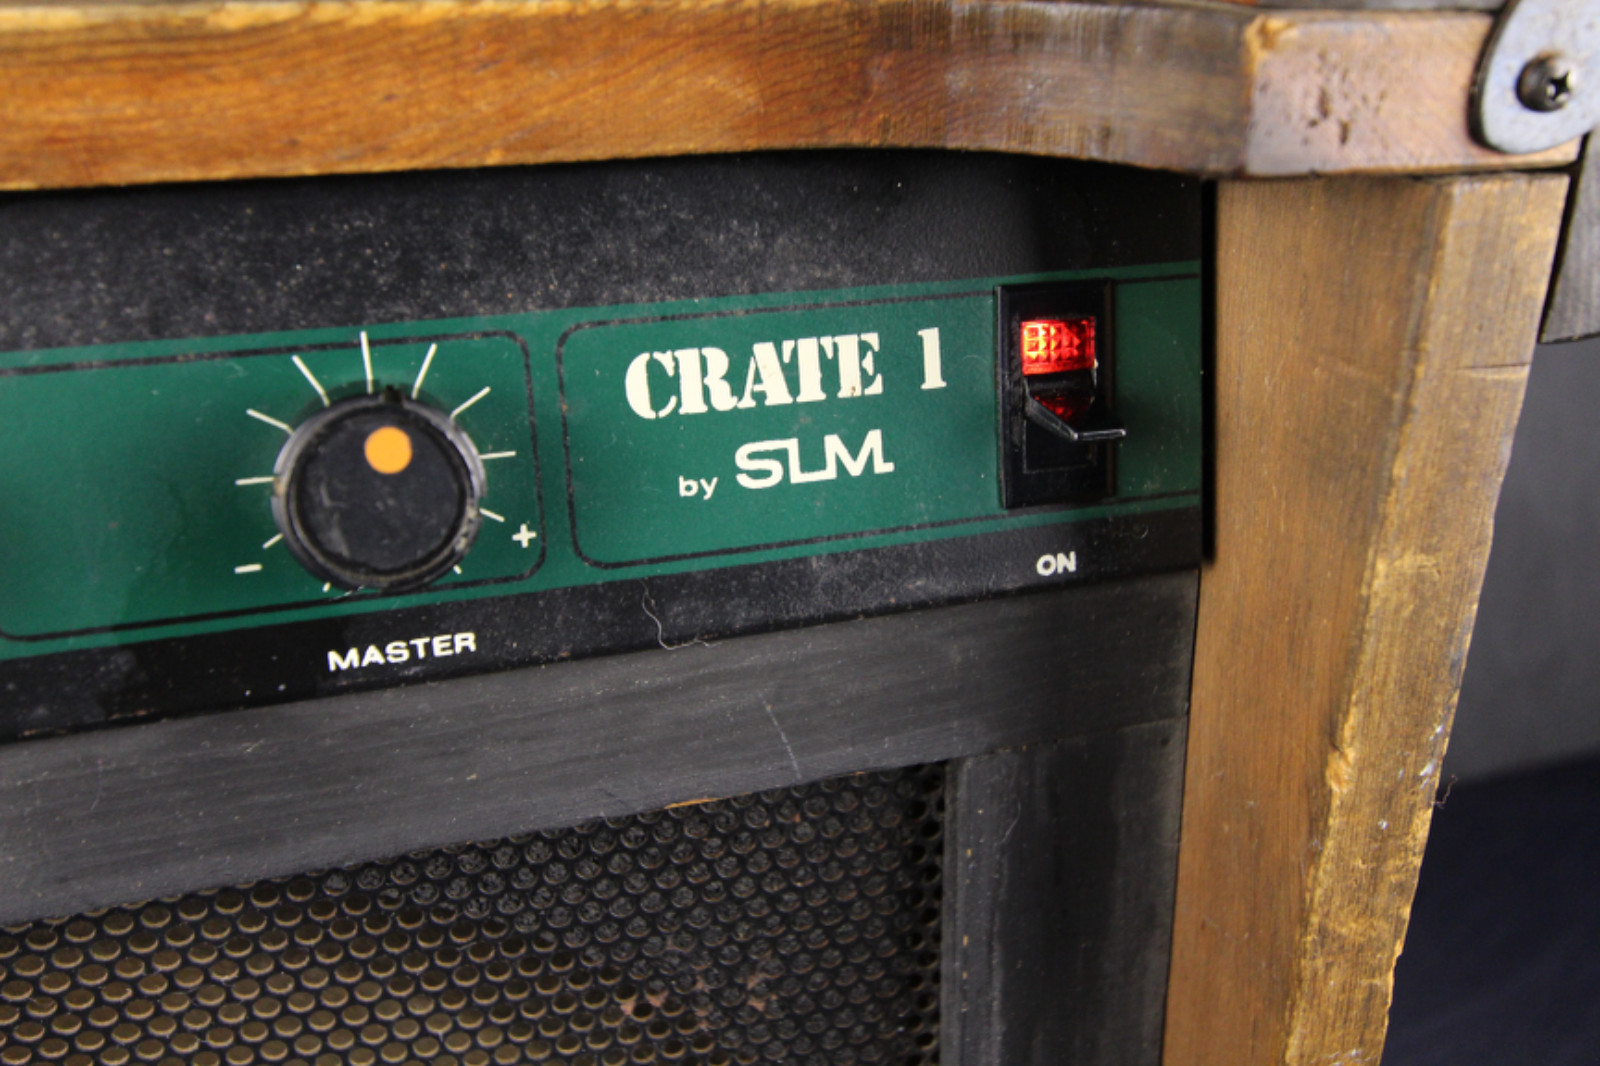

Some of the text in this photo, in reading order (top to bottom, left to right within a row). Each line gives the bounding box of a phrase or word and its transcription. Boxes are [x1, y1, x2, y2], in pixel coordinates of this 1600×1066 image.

[624, 326, 947, 420] CRATE 1
[678, 428, 895, 501] by SLM
[1036, 551, 1077, 577] ON
[327, 632, 477, 673] MASTER
